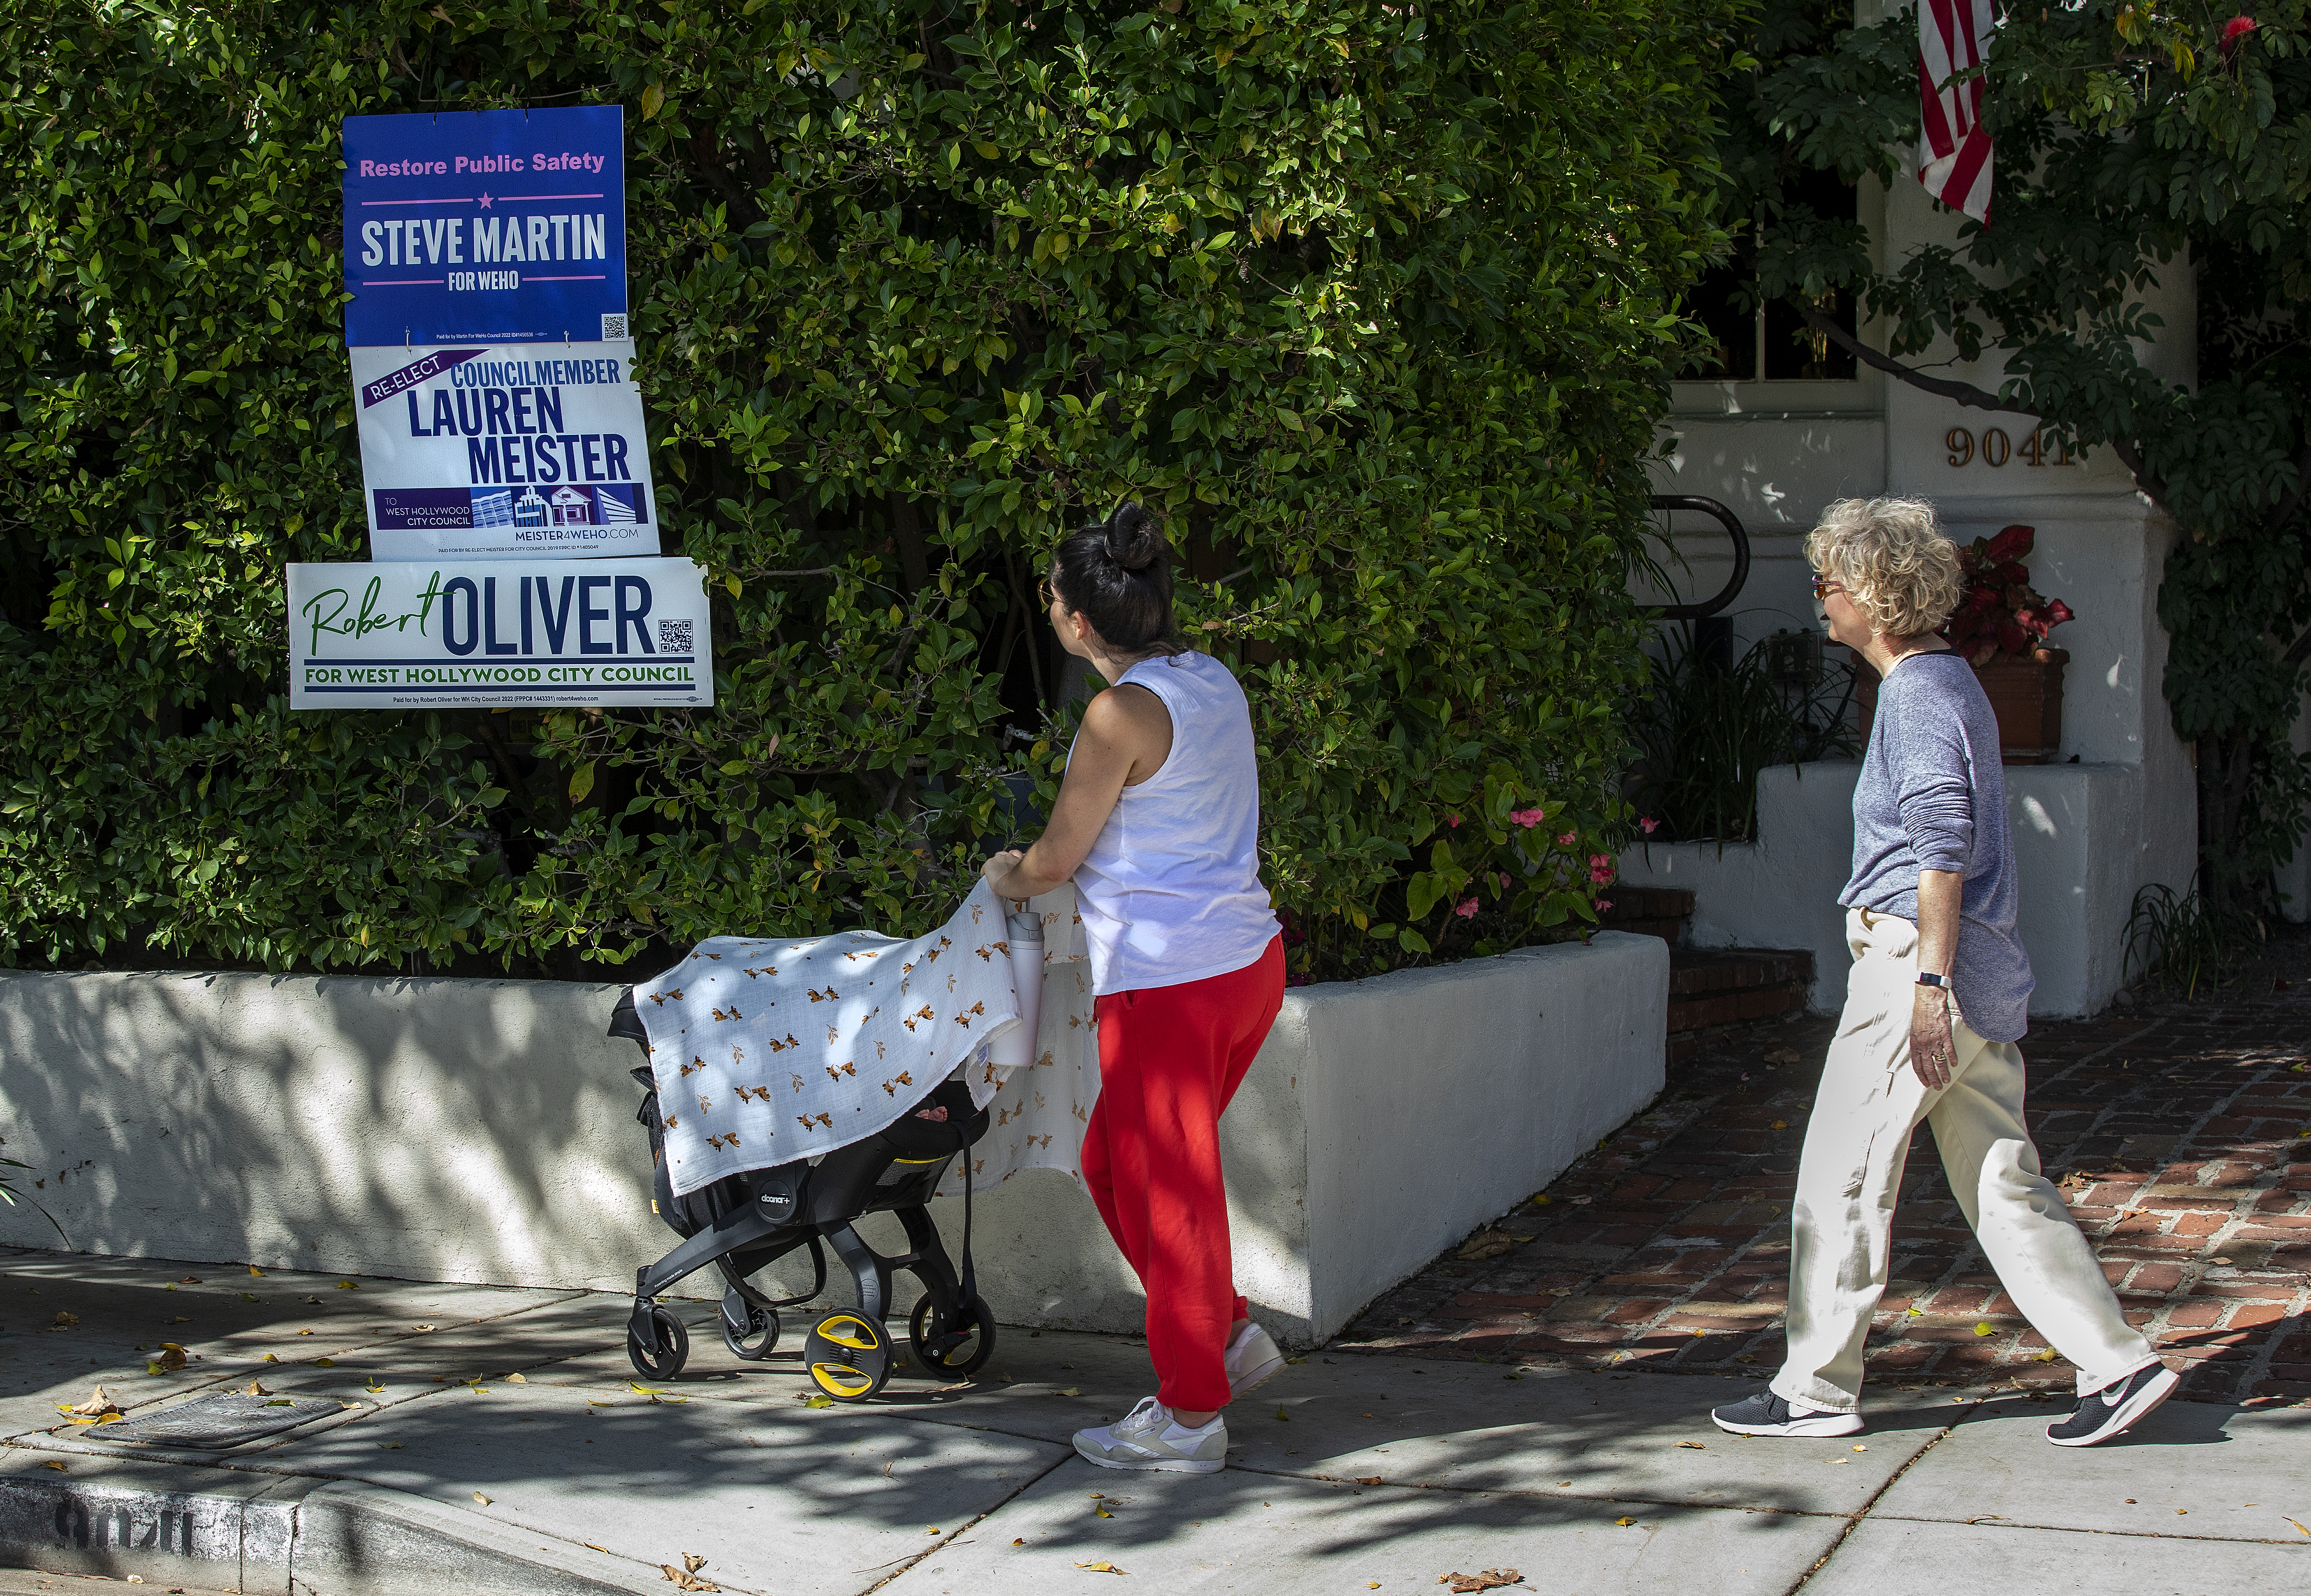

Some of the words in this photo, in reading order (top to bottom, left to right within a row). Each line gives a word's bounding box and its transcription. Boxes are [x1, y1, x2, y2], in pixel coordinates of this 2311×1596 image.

[361, 159, 447, 177] Restore
[456, 155, 524, 173] Public
[533, 152, 604, 173] Safety
[362, 219, 463, 266] STEVE
[474, 214, 605, 262] MARTIN
[449, 272, 475, 291] FOR
[478, 270, 518, 290] WEHO
[370, 355, 441, 399] RE-ELECT
[451, 359, 621, 387] COUNCILMEMBER
[407, 387, 564, 437] LAUREN
[467, 434, 631, 484] MEISTER
[516, 529, 638, 541] MEISTER4WEHO.COM
[302, 570, 457, 656] Robert
[442, 575, 656, 656] OLIVER
[306, 669, 342, 683] FOR
[347, 669, 399, 683] WEST
[406, 668, 540, 683] HOLLYWOOD
[548, 668, 595, 682] CITY
[602, 667, 694, 681] COUNCIL
